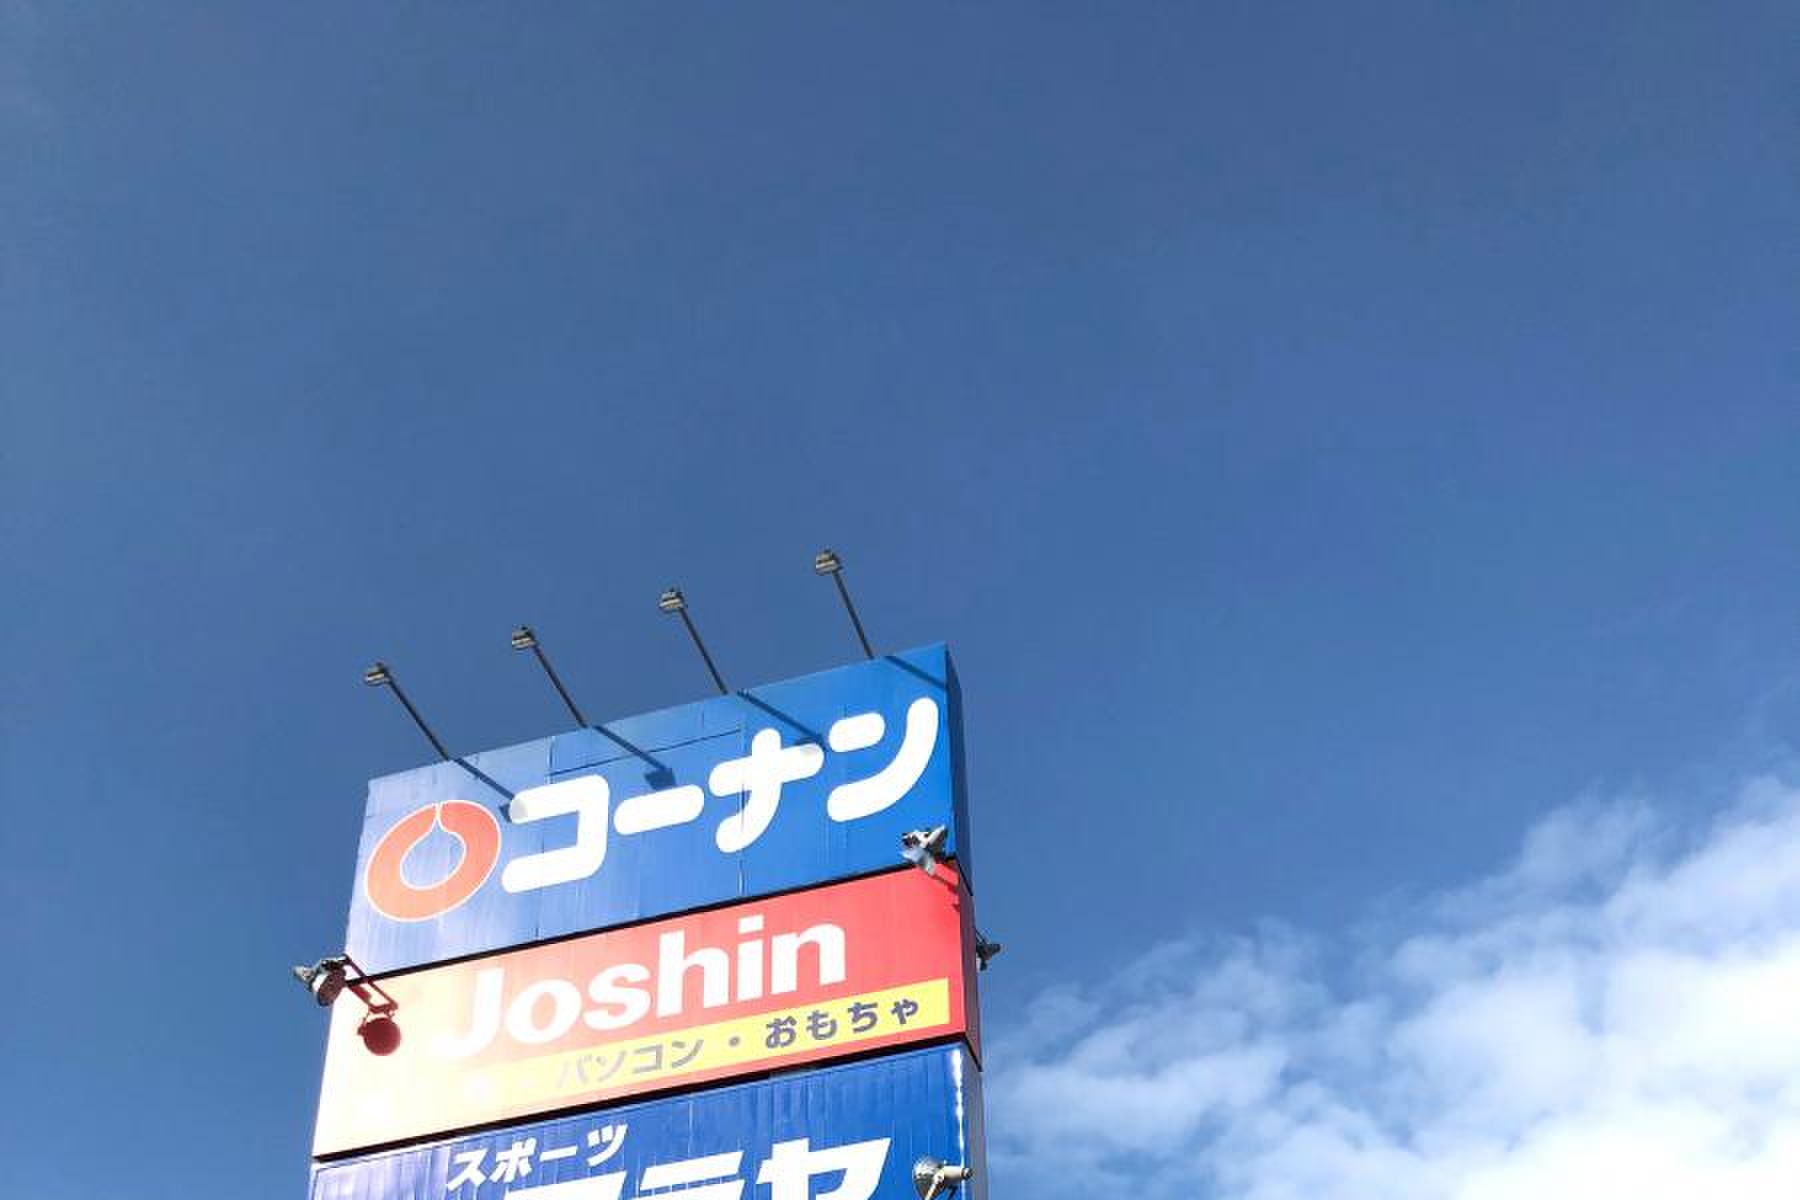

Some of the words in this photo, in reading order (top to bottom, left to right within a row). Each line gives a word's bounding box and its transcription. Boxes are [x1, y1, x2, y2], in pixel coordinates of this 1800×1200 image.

[501, 697, 939, 893] コーナン
[434, 915, 846, 1058] Joshin
[446, 1124, 628, 1192] スポーツ
